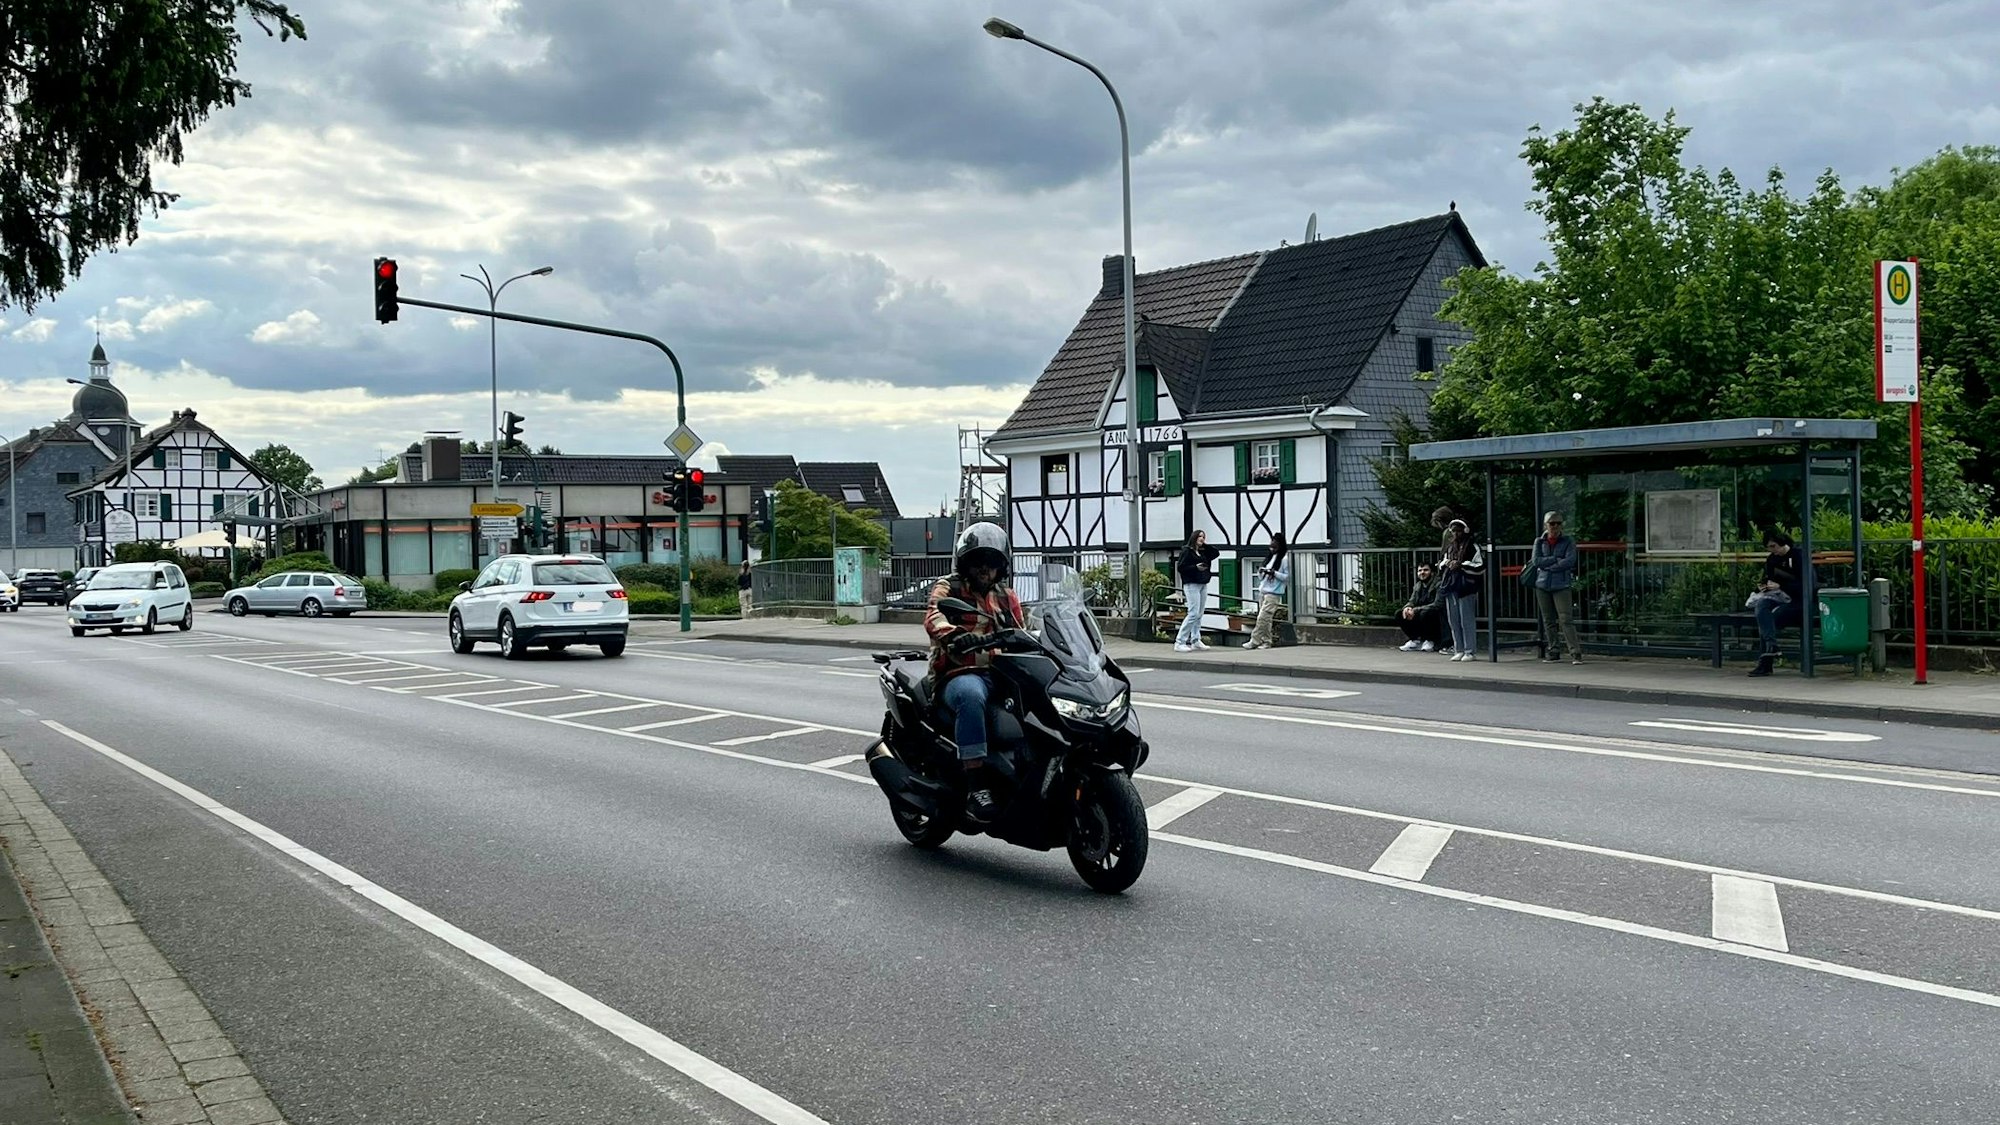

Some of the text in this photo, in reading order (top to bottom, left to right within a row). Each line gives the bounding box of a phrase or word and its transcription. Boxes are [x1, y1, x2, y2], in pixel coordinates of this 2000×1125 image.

[1894, 273, 1905, 297] H
[1107, 426, 1178, 444] ANN 1766
